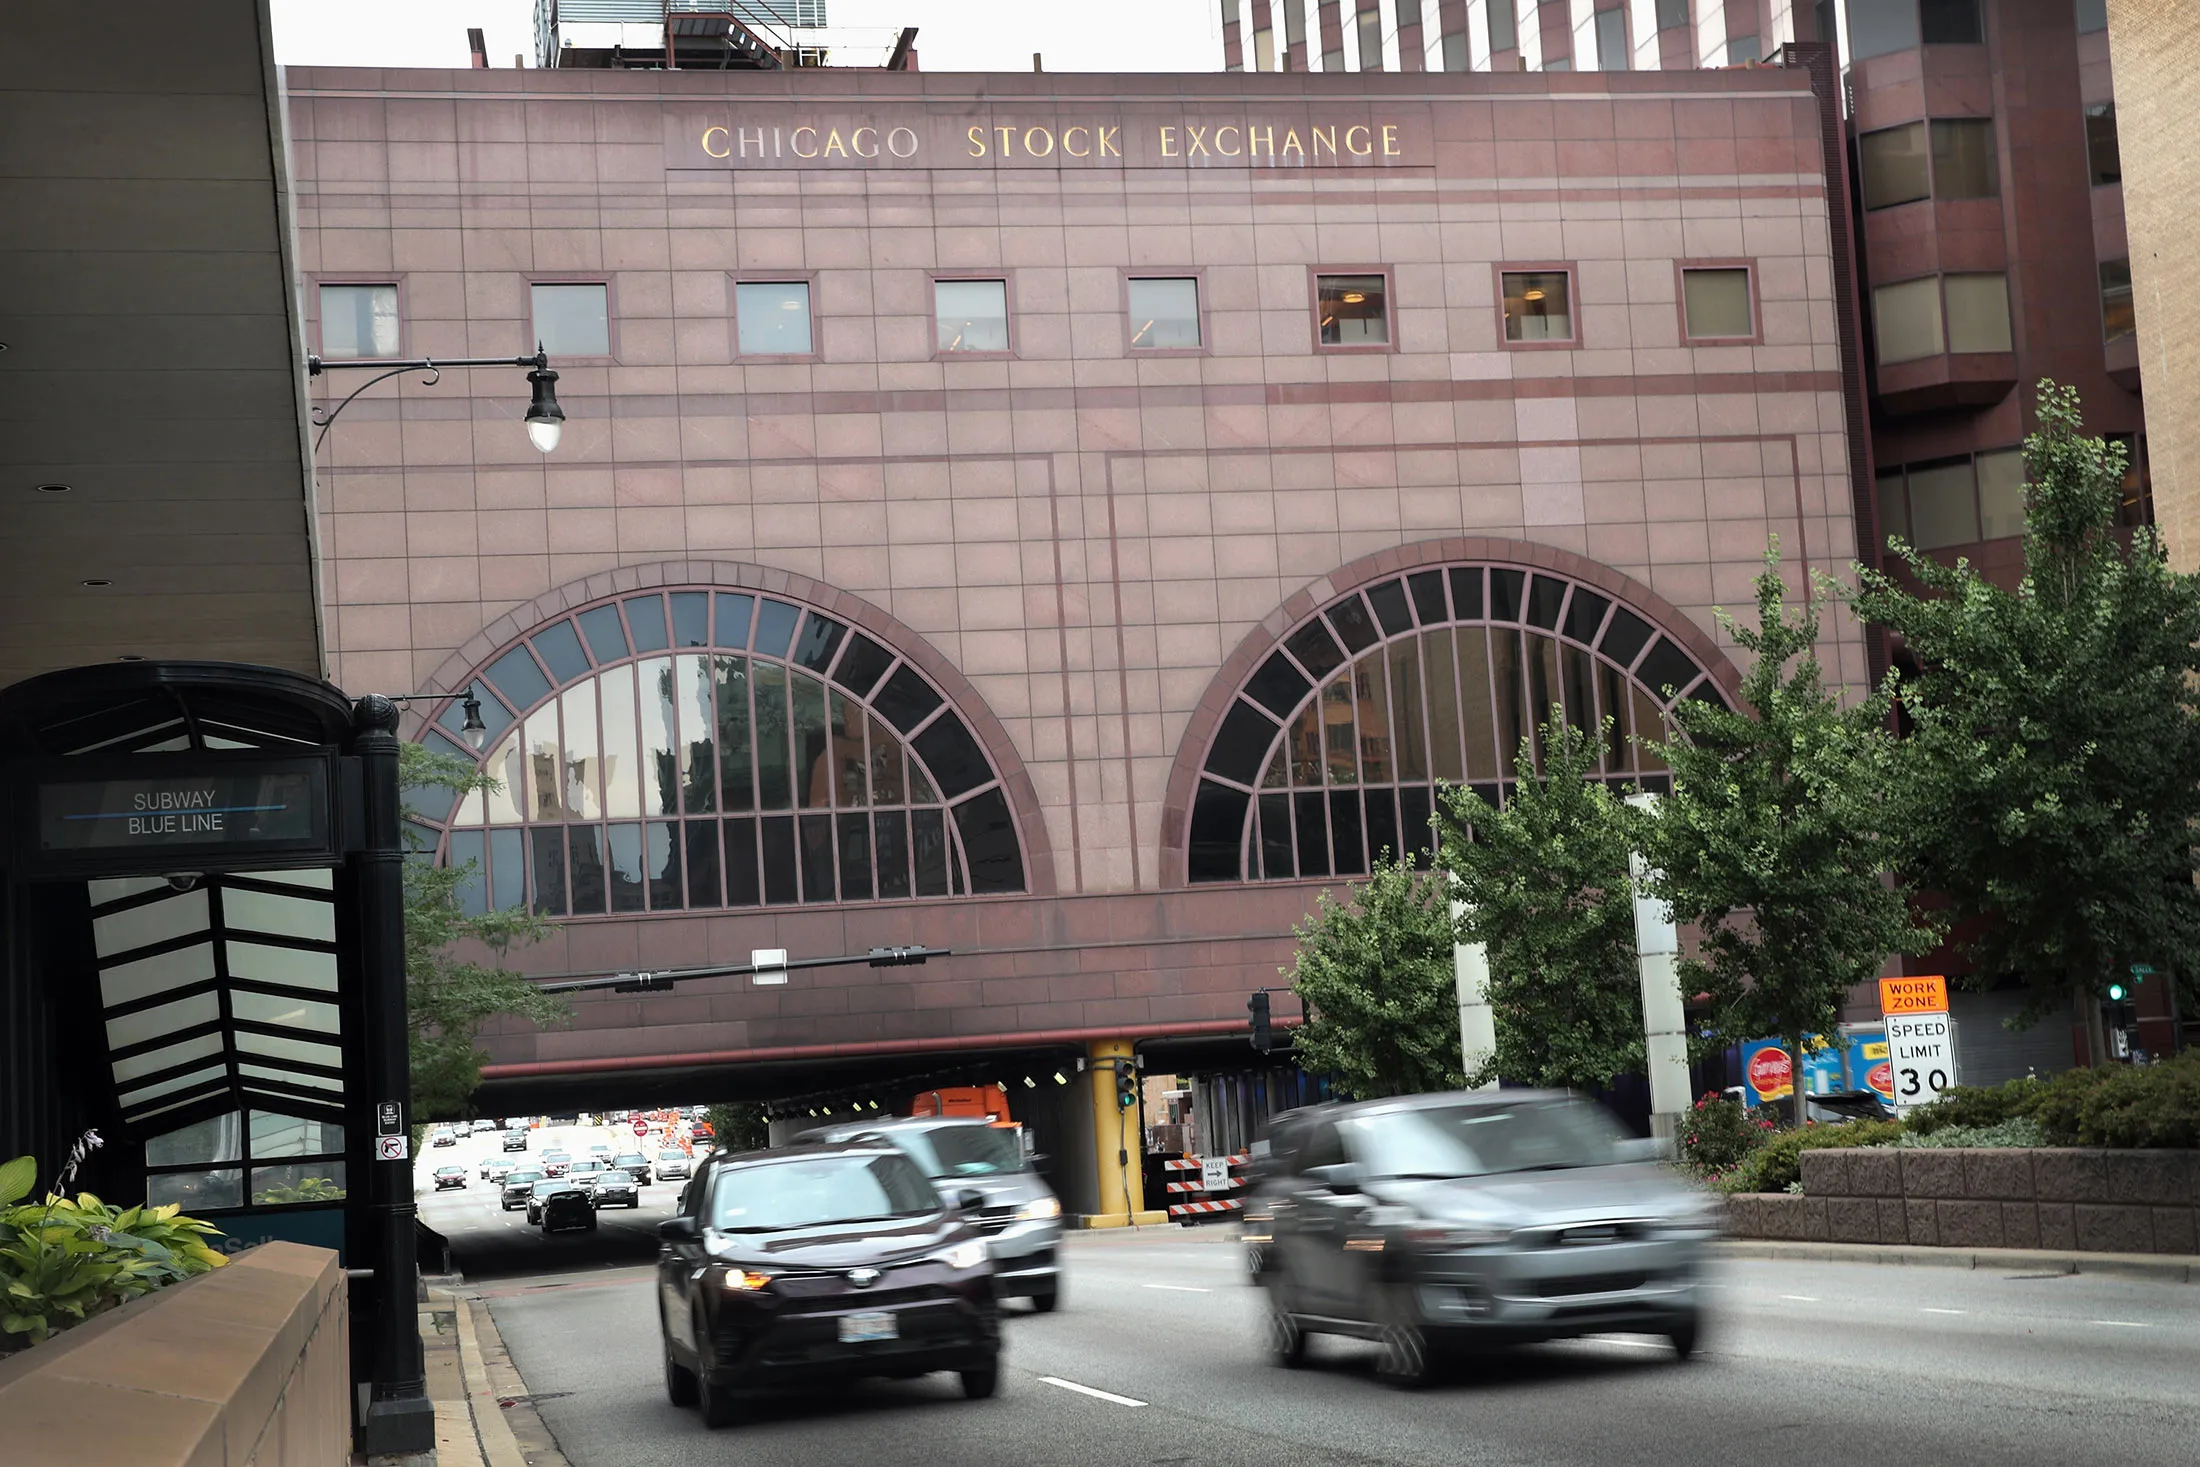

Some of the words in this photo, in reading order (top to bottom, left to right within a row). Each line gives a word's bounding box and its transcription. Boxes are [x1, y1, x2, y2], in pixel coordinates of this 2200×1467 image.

[701, 126, 919, 158] CHICAGO
[967, 126, 1121, 157] STOCK
[1158, 125, 1401, 156] EXCHANGE
[134, 790, 215, 810] SUBWAY
[129, 816, 176, 834] BLUE
[182, 814, 223, 832] LINE
[1889, 982, 1937, 995] WORK
[1893, 996, 1937, 1010] ZONE
[1891, 1023, 1946, 1038] SPEED
[1900, 1044, 1942, 1060] LIMIT
[1900, 1068, 1948, 1096] 30
[1206, 1178, 1226, 1187] RIGHT
